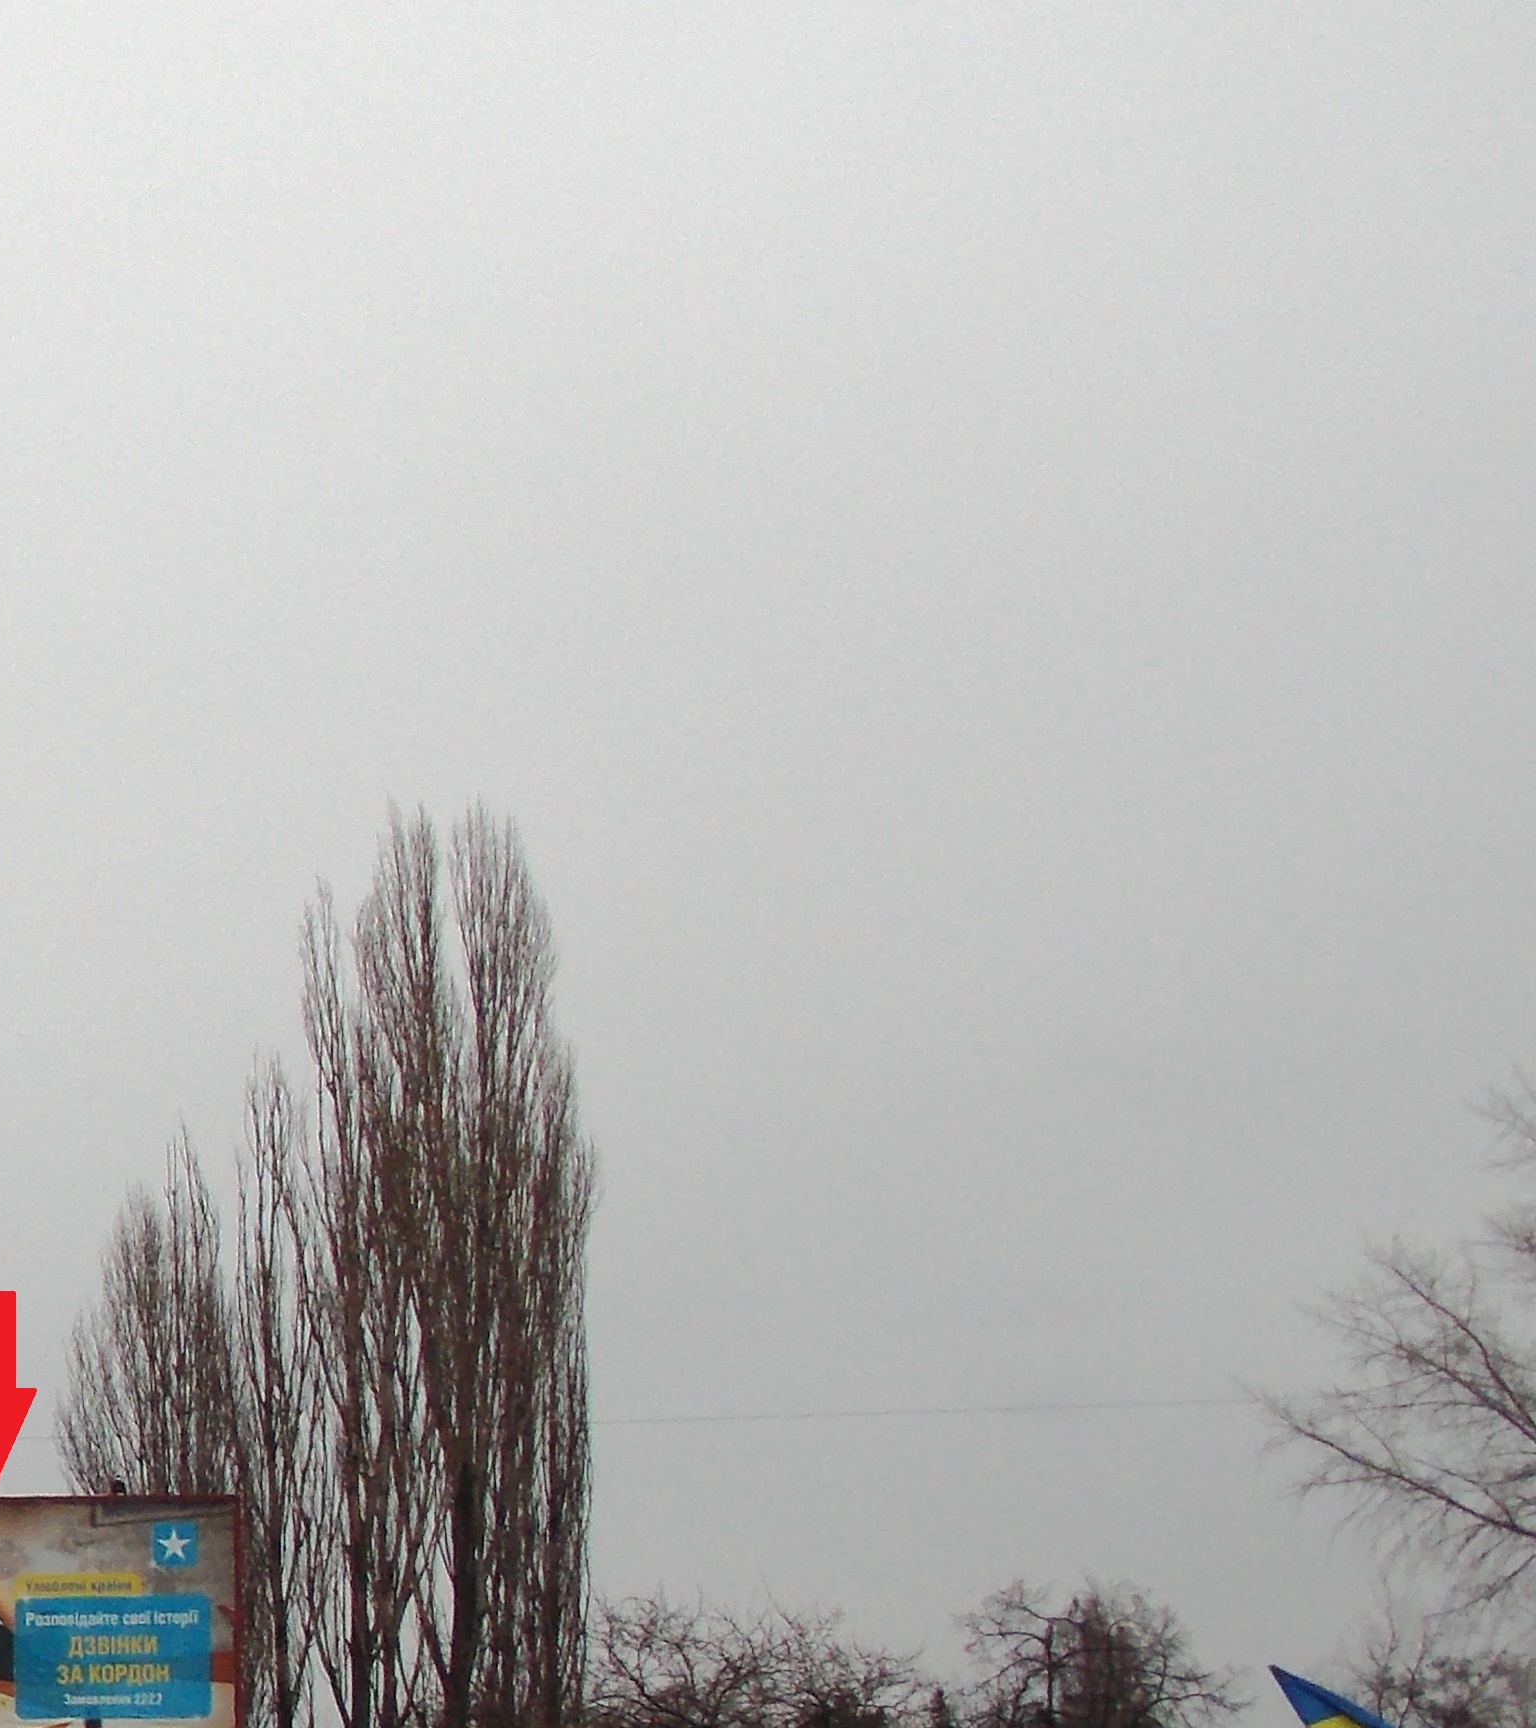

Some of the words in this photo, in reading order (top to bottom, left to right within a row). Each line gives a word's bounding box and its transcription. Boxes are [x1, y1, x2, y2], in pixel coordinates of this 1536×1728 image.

[26, 1611, 118, 1628] Розповідайте
[68, 1635, 158, 1658] ДЗВІНКИ
[56, 1664, 84, 1684] ЗА
[89, 1664, 171, 1686] КОРДОН
